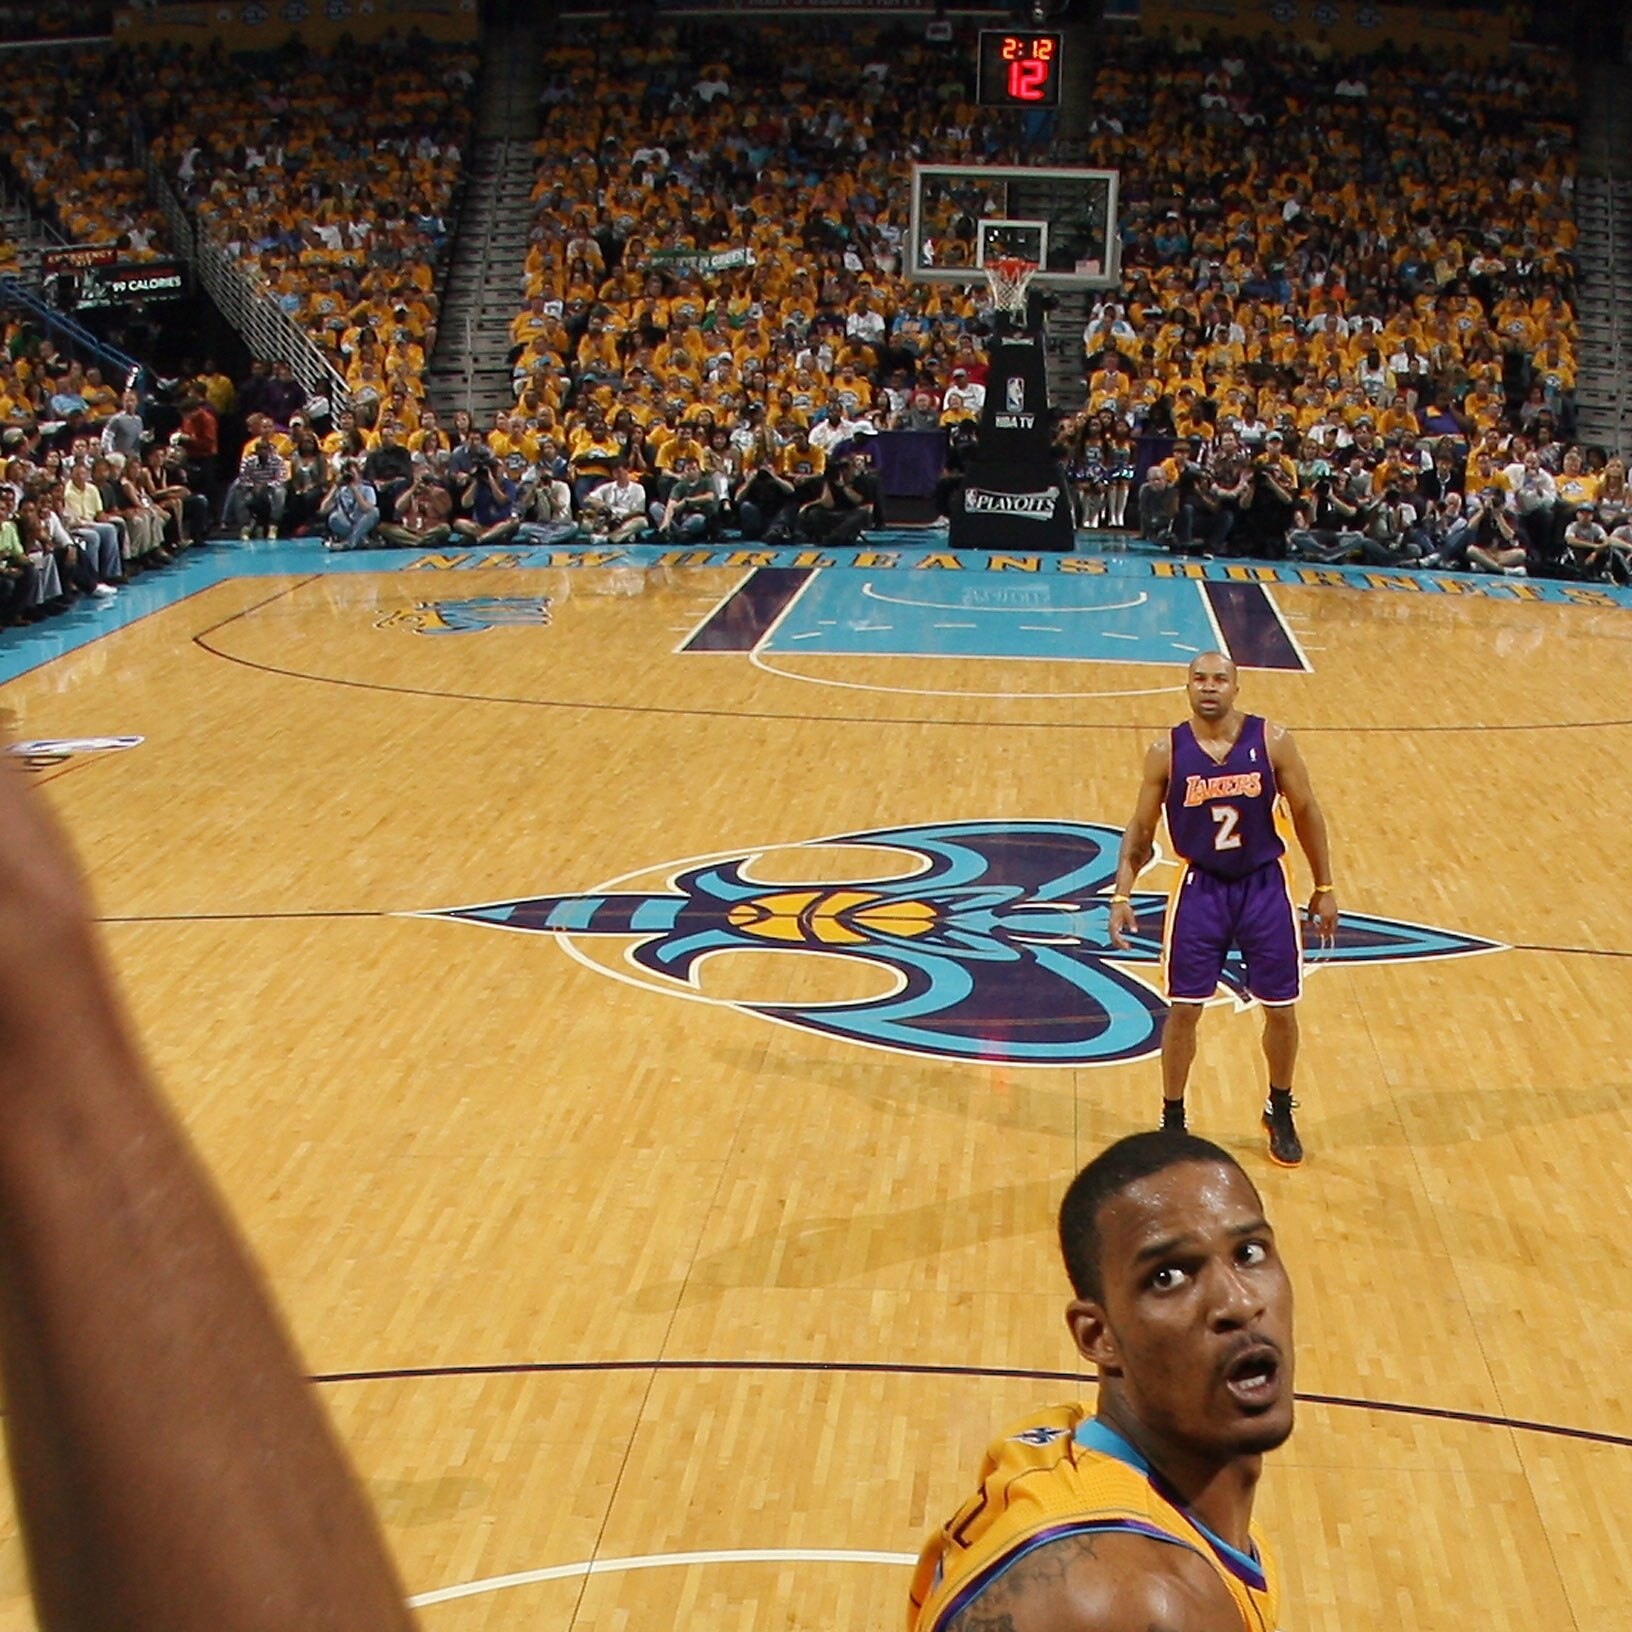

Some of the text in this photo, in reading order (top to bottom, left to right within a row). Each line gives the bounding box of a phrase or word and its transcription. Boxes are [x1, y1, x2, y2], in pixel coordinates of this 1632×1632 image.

[1002, 37, 1052, 60] 2:12
[1007, 60, 1049, 101] 12
[128, 275, 183, 292] CALORIES
[995, 415, 1036, 430] NBA TV
[976, 493, 1058, 513] PLAYOFFS
[399, 549, 1622, 608] NEW ORLEANS HORNETS
[1183, 771, 1262, 808] LAKERS
[1211, 804, 1242, 852] 2
